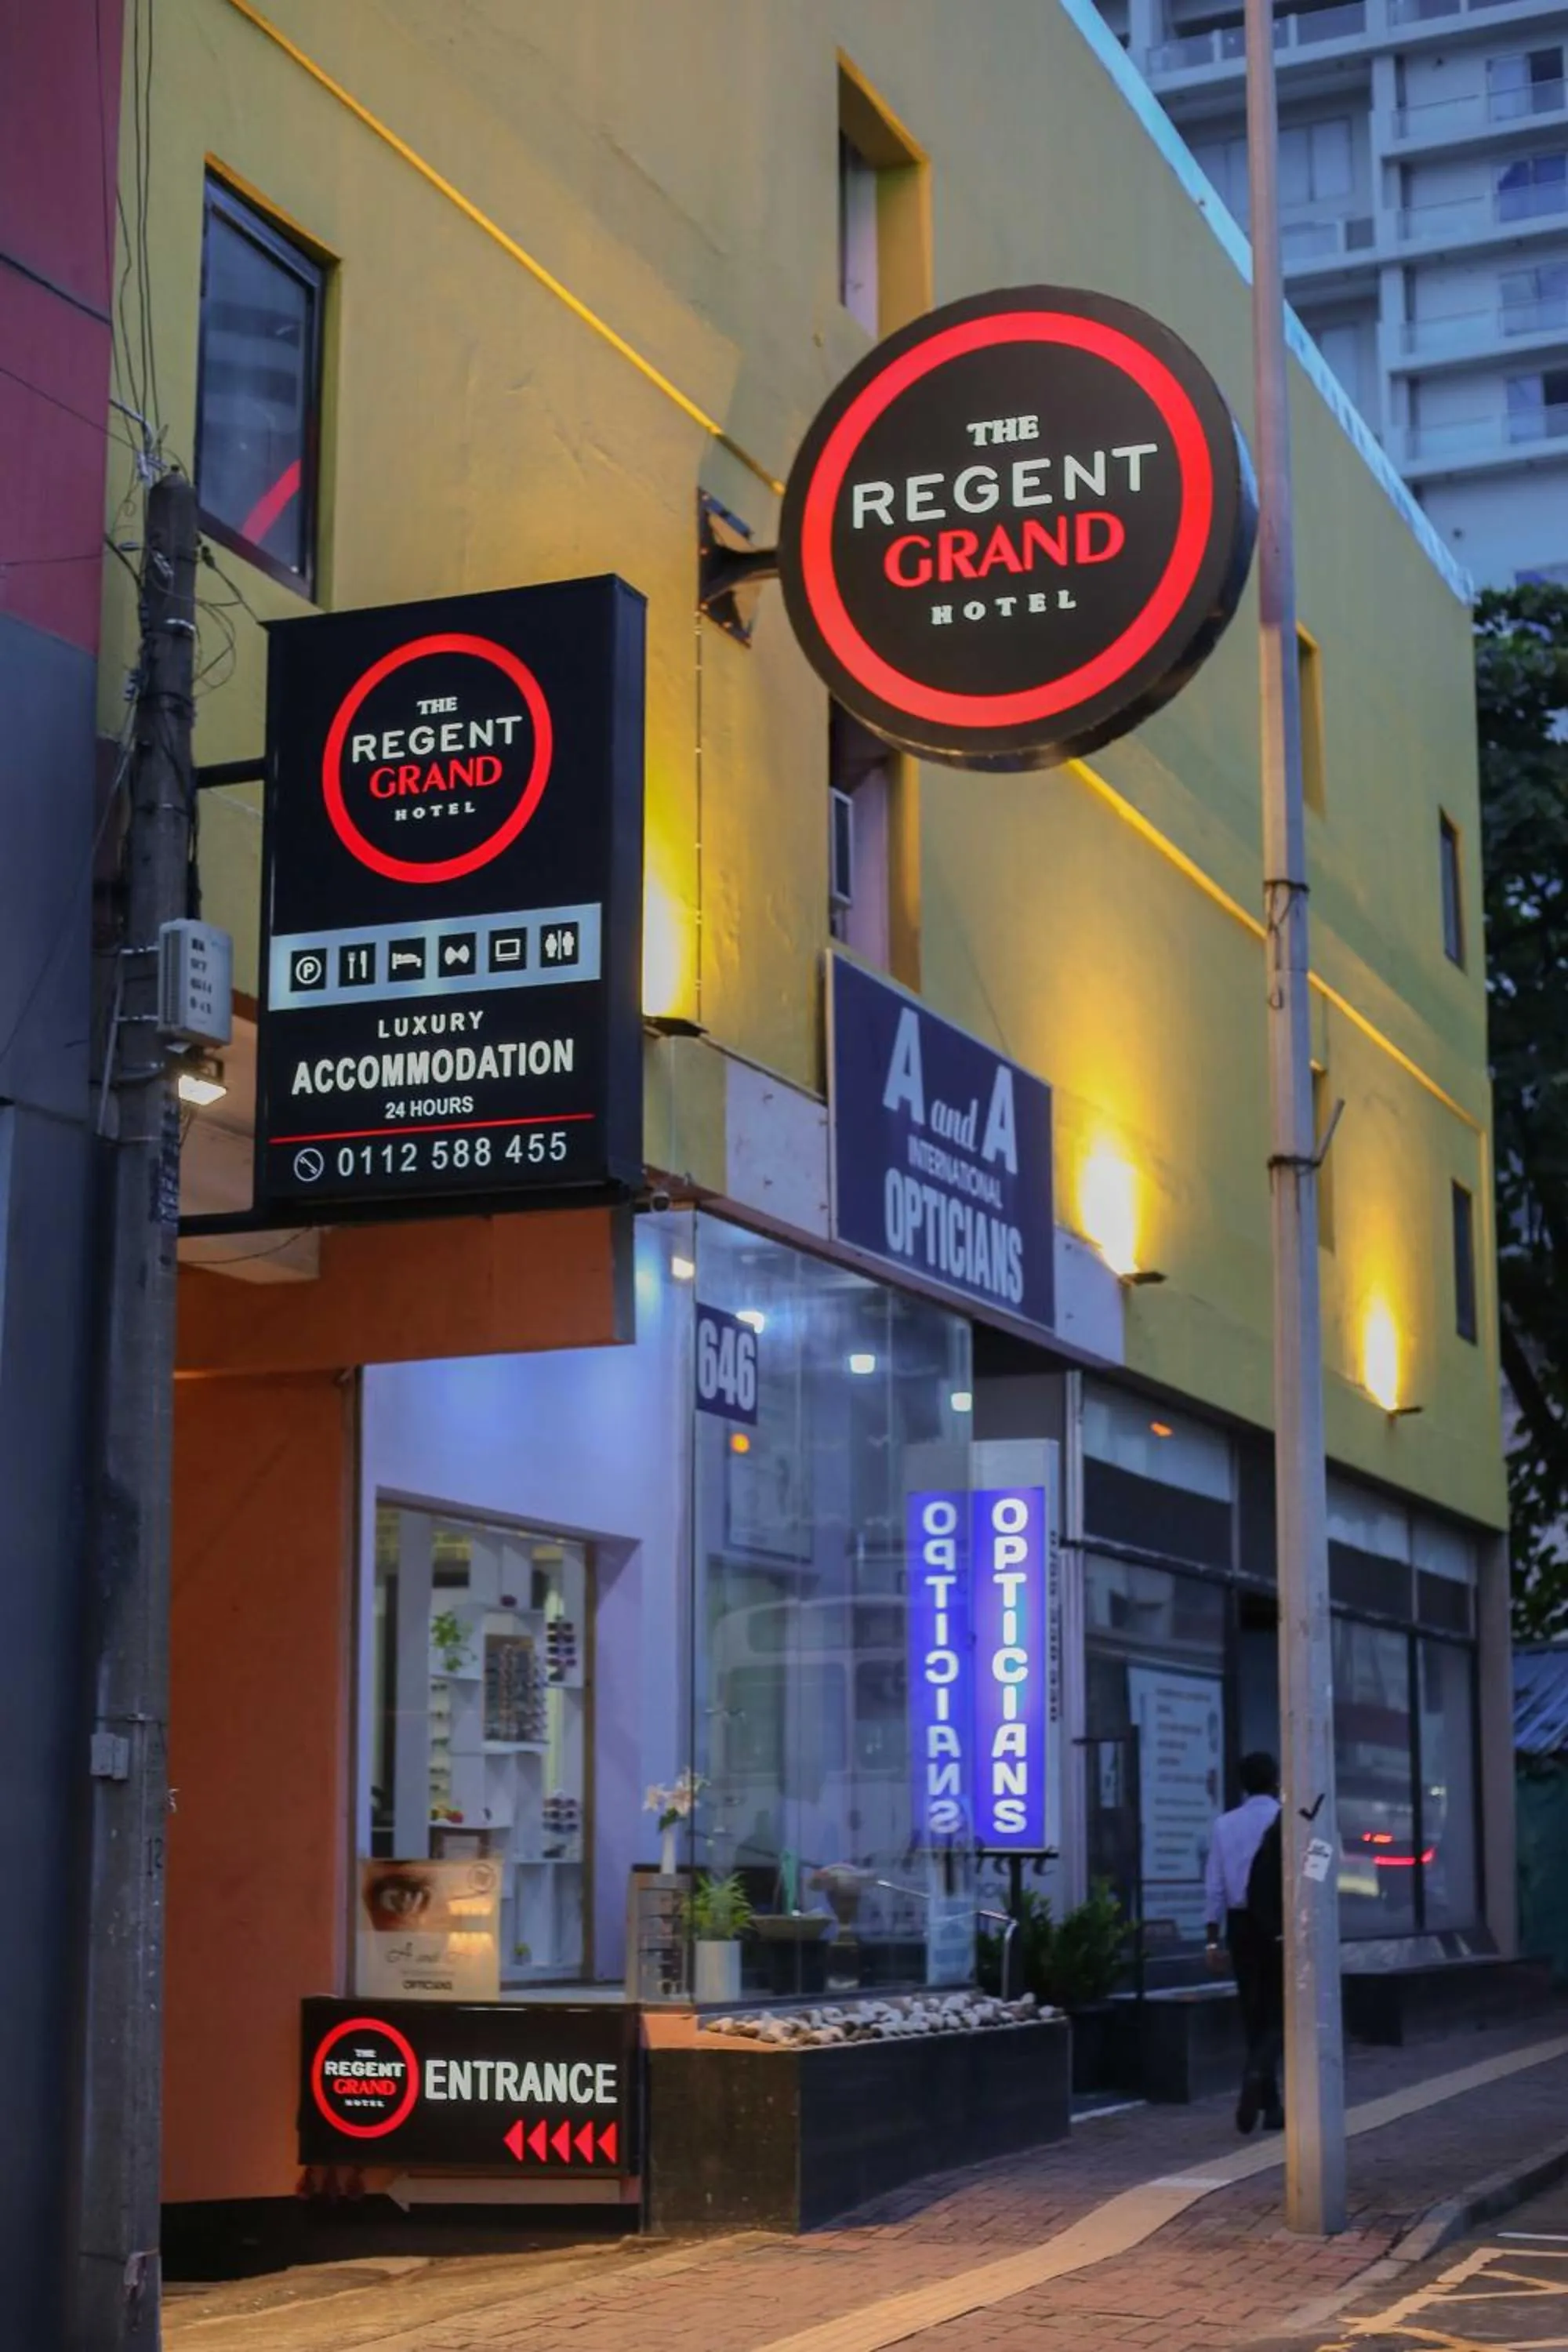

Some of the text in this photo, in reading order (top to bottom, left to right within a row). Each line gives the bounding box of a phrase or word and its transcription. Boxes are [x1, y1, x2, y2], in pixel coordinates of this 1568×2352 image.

[967, 415, 1040, 447] THE
[852, 444, 1158, 529] REGENT
[883, 511, 1125, 587] GRAND
[932, 590, 1076, 625] HOTEL
[417, 696, 458, 715] THE
[351, 716, 523, 763] REGENT
[369, 755, 503, 799] GRAND
[394, 800, 476, 821] HOTEL
[378, 1011, 484, 1039] LUXURY
[291, 1038, 575, 1095] ACCOMMODATION
[385, 1096, 474, 1120] 24 HOURS
[883, 1007, 1018, 1175] A and A
[337, 1131, 567, 1177] 0112 588 455
[907, 1134, 1003, 1210] INTERNATIONAL
[884, 1167, 1024, 1304] OPTICIANS
[698, 1318, 756, 1410] 646
[992, 1497, 1029, 1834] OPTICIANS
[325, 2060, 405, 2078] REGENT
[333, 2078, 397, 2096] GRAND
[425, 2060, 618, 2103] ENTRANCE
